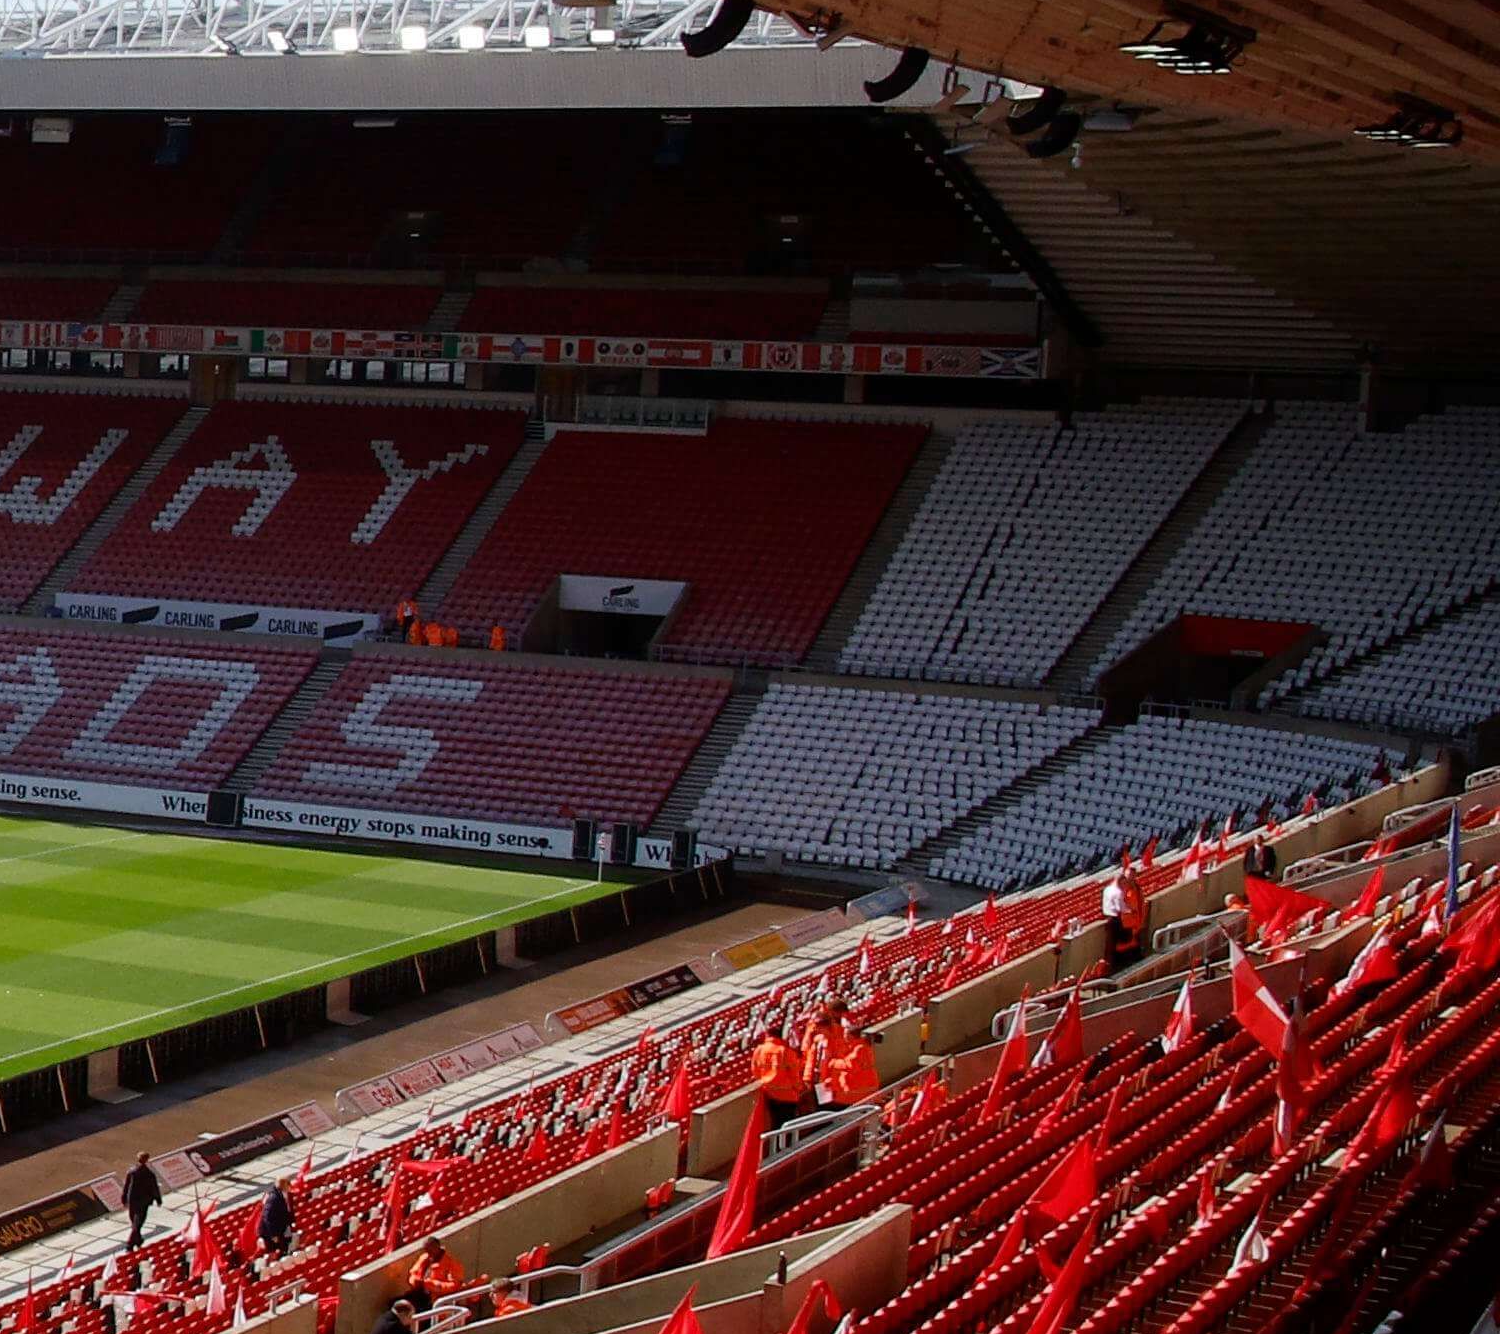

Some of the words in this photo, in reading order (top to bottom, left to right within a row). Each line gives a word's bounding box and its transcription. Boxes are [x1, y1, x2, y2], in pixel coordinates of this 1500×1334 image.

[601, 596, 640, 609] CARLING
[68, 605, 117, 622] CARLING
[164, 611, 214, 627] CARLING
[267, 618, 318, 635] CARLING
[31, 783, 82, 802] sense.
[299, 813, 361, 835] energy
[367, 817, 415, 837] stops
[421, 821, 491, 847] making
